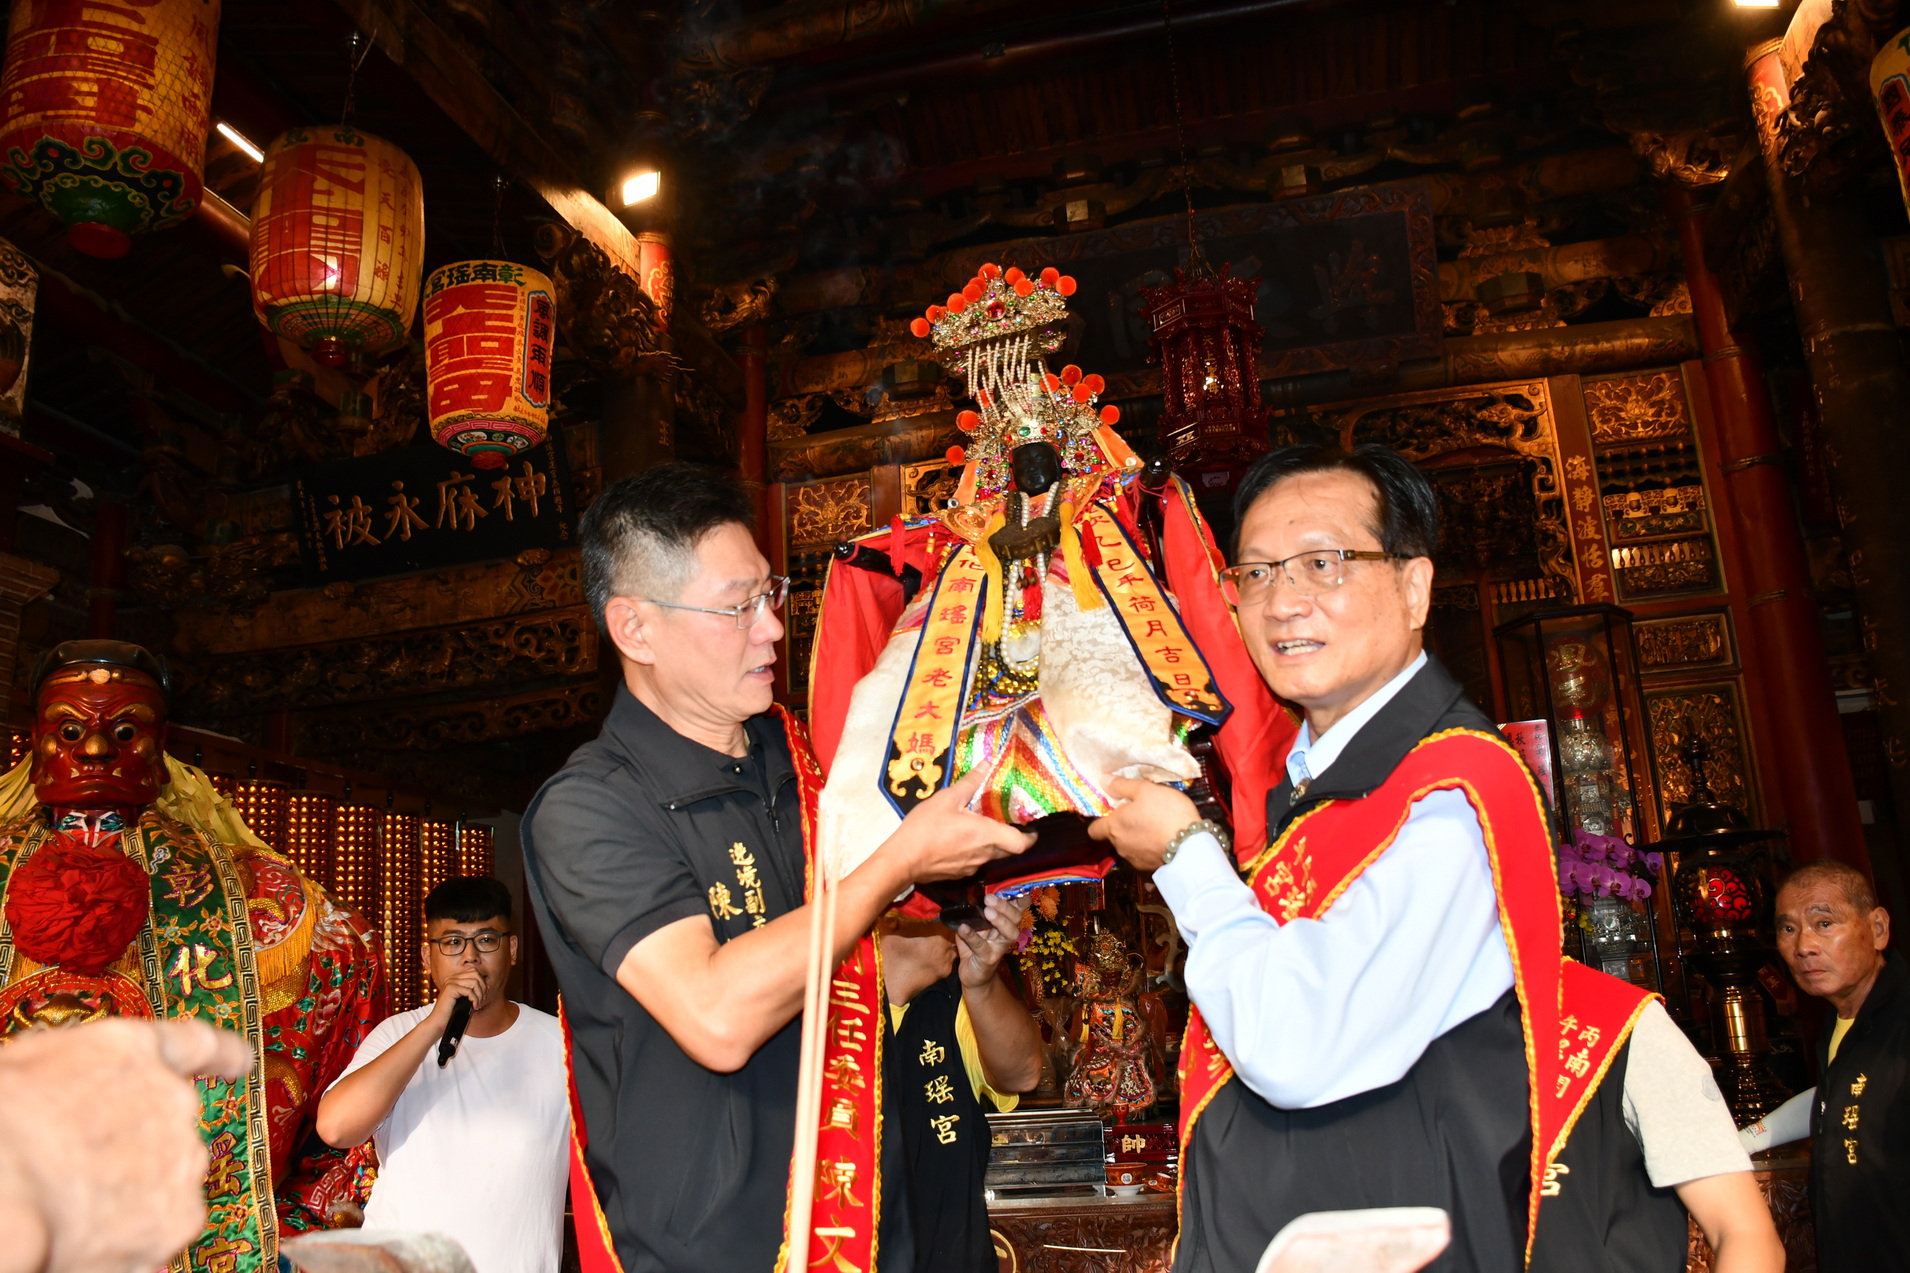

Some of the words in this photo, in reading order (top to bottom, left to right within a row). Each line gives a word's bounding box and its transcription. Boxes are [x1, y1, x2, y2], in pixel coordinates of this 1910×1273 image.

[528, 298, 551, 397] 風調雨順
[907, 547, 985, 757] 化南瑤宮老大媽
[708, 880, 743, 935] 陳
[818, 942, 871, 1141] 主任委員
[918, 1038, 961, 1145] 南瑤宮
[1121, 1134, 1146, 1154] 帥
